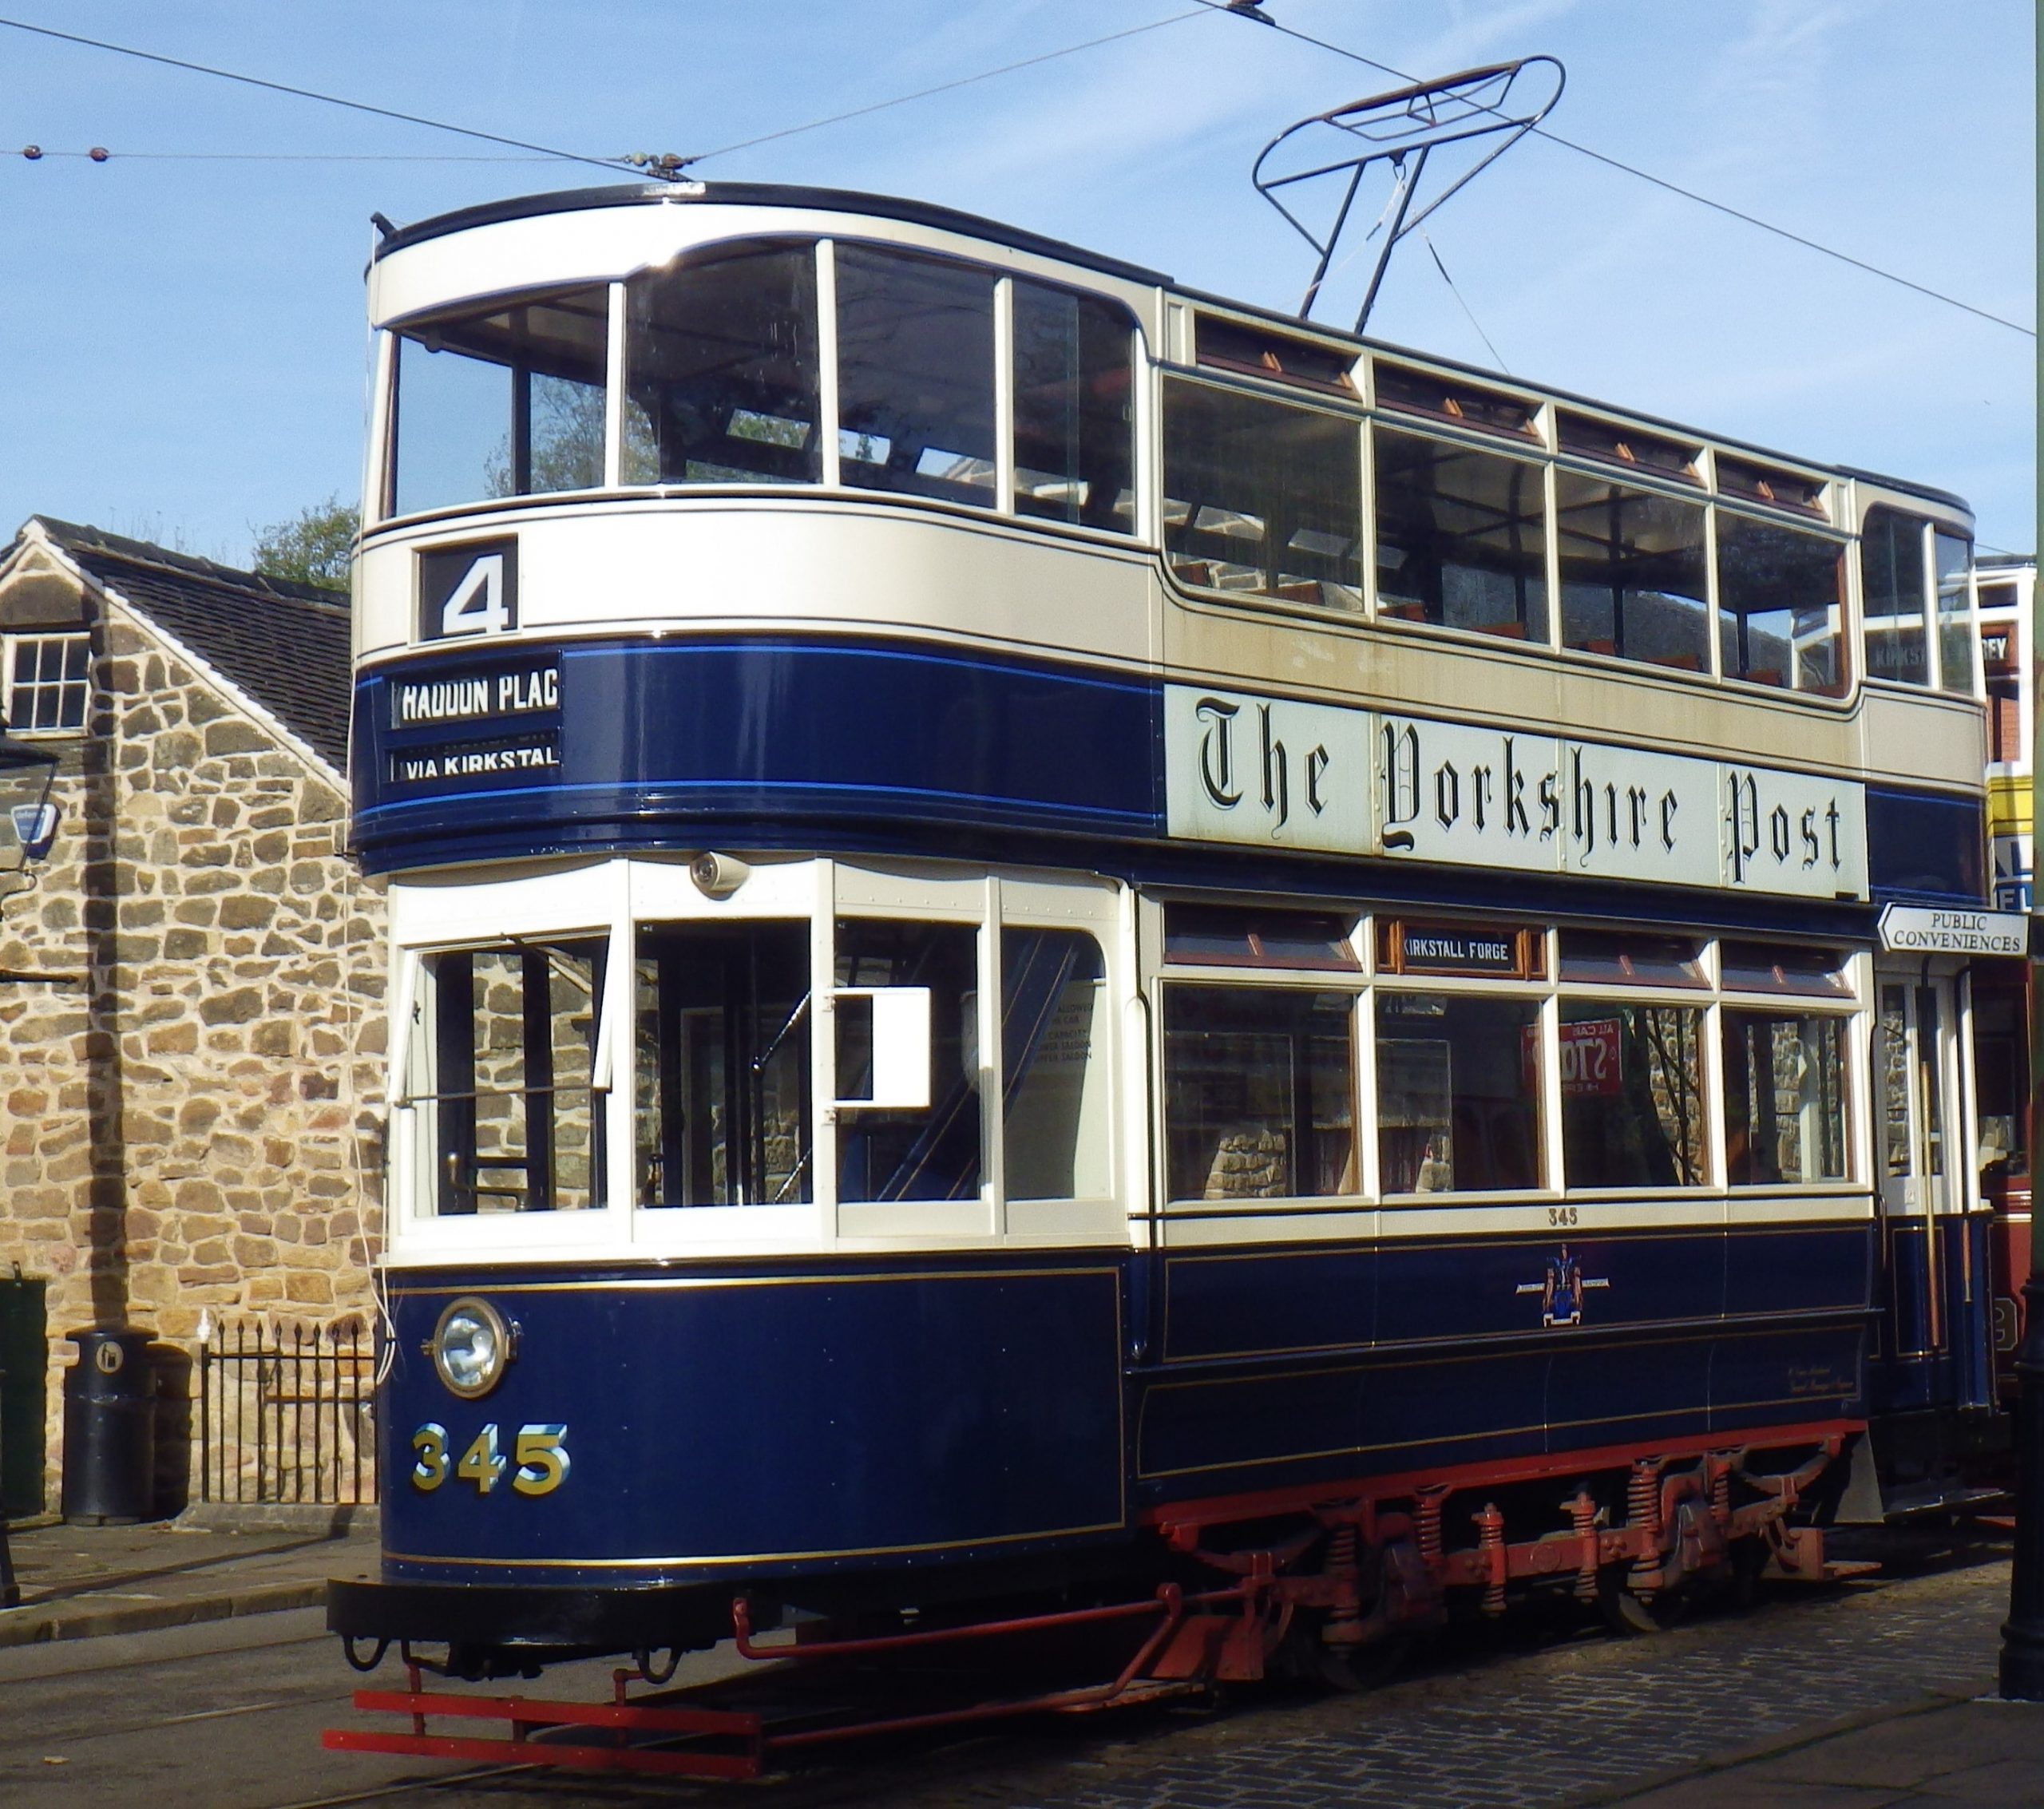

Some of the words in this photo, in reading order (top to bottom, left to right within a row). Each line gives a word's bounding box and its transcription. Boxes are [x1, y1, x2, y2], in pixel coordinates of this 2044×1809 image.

[443, 554, 509, 634] 4
[406, 758, 438, 779] VIA
[1195, 696, 1329, 840] The
[1379, 719, 1678, 868] Yorkshire
[1725, 770, 1842, 885] Post
[1931, 912, 1987, 931] PUBLIC
[1404, 938, 1465, 958] KIRKSTALL
[1469, 941, 1509, 960] FORGE
[1893, 929, 2021, 952] CONVENIENCES
[1548, 1206, 1578, 1227] 345
[412, 1422, 572, 1496] 345
